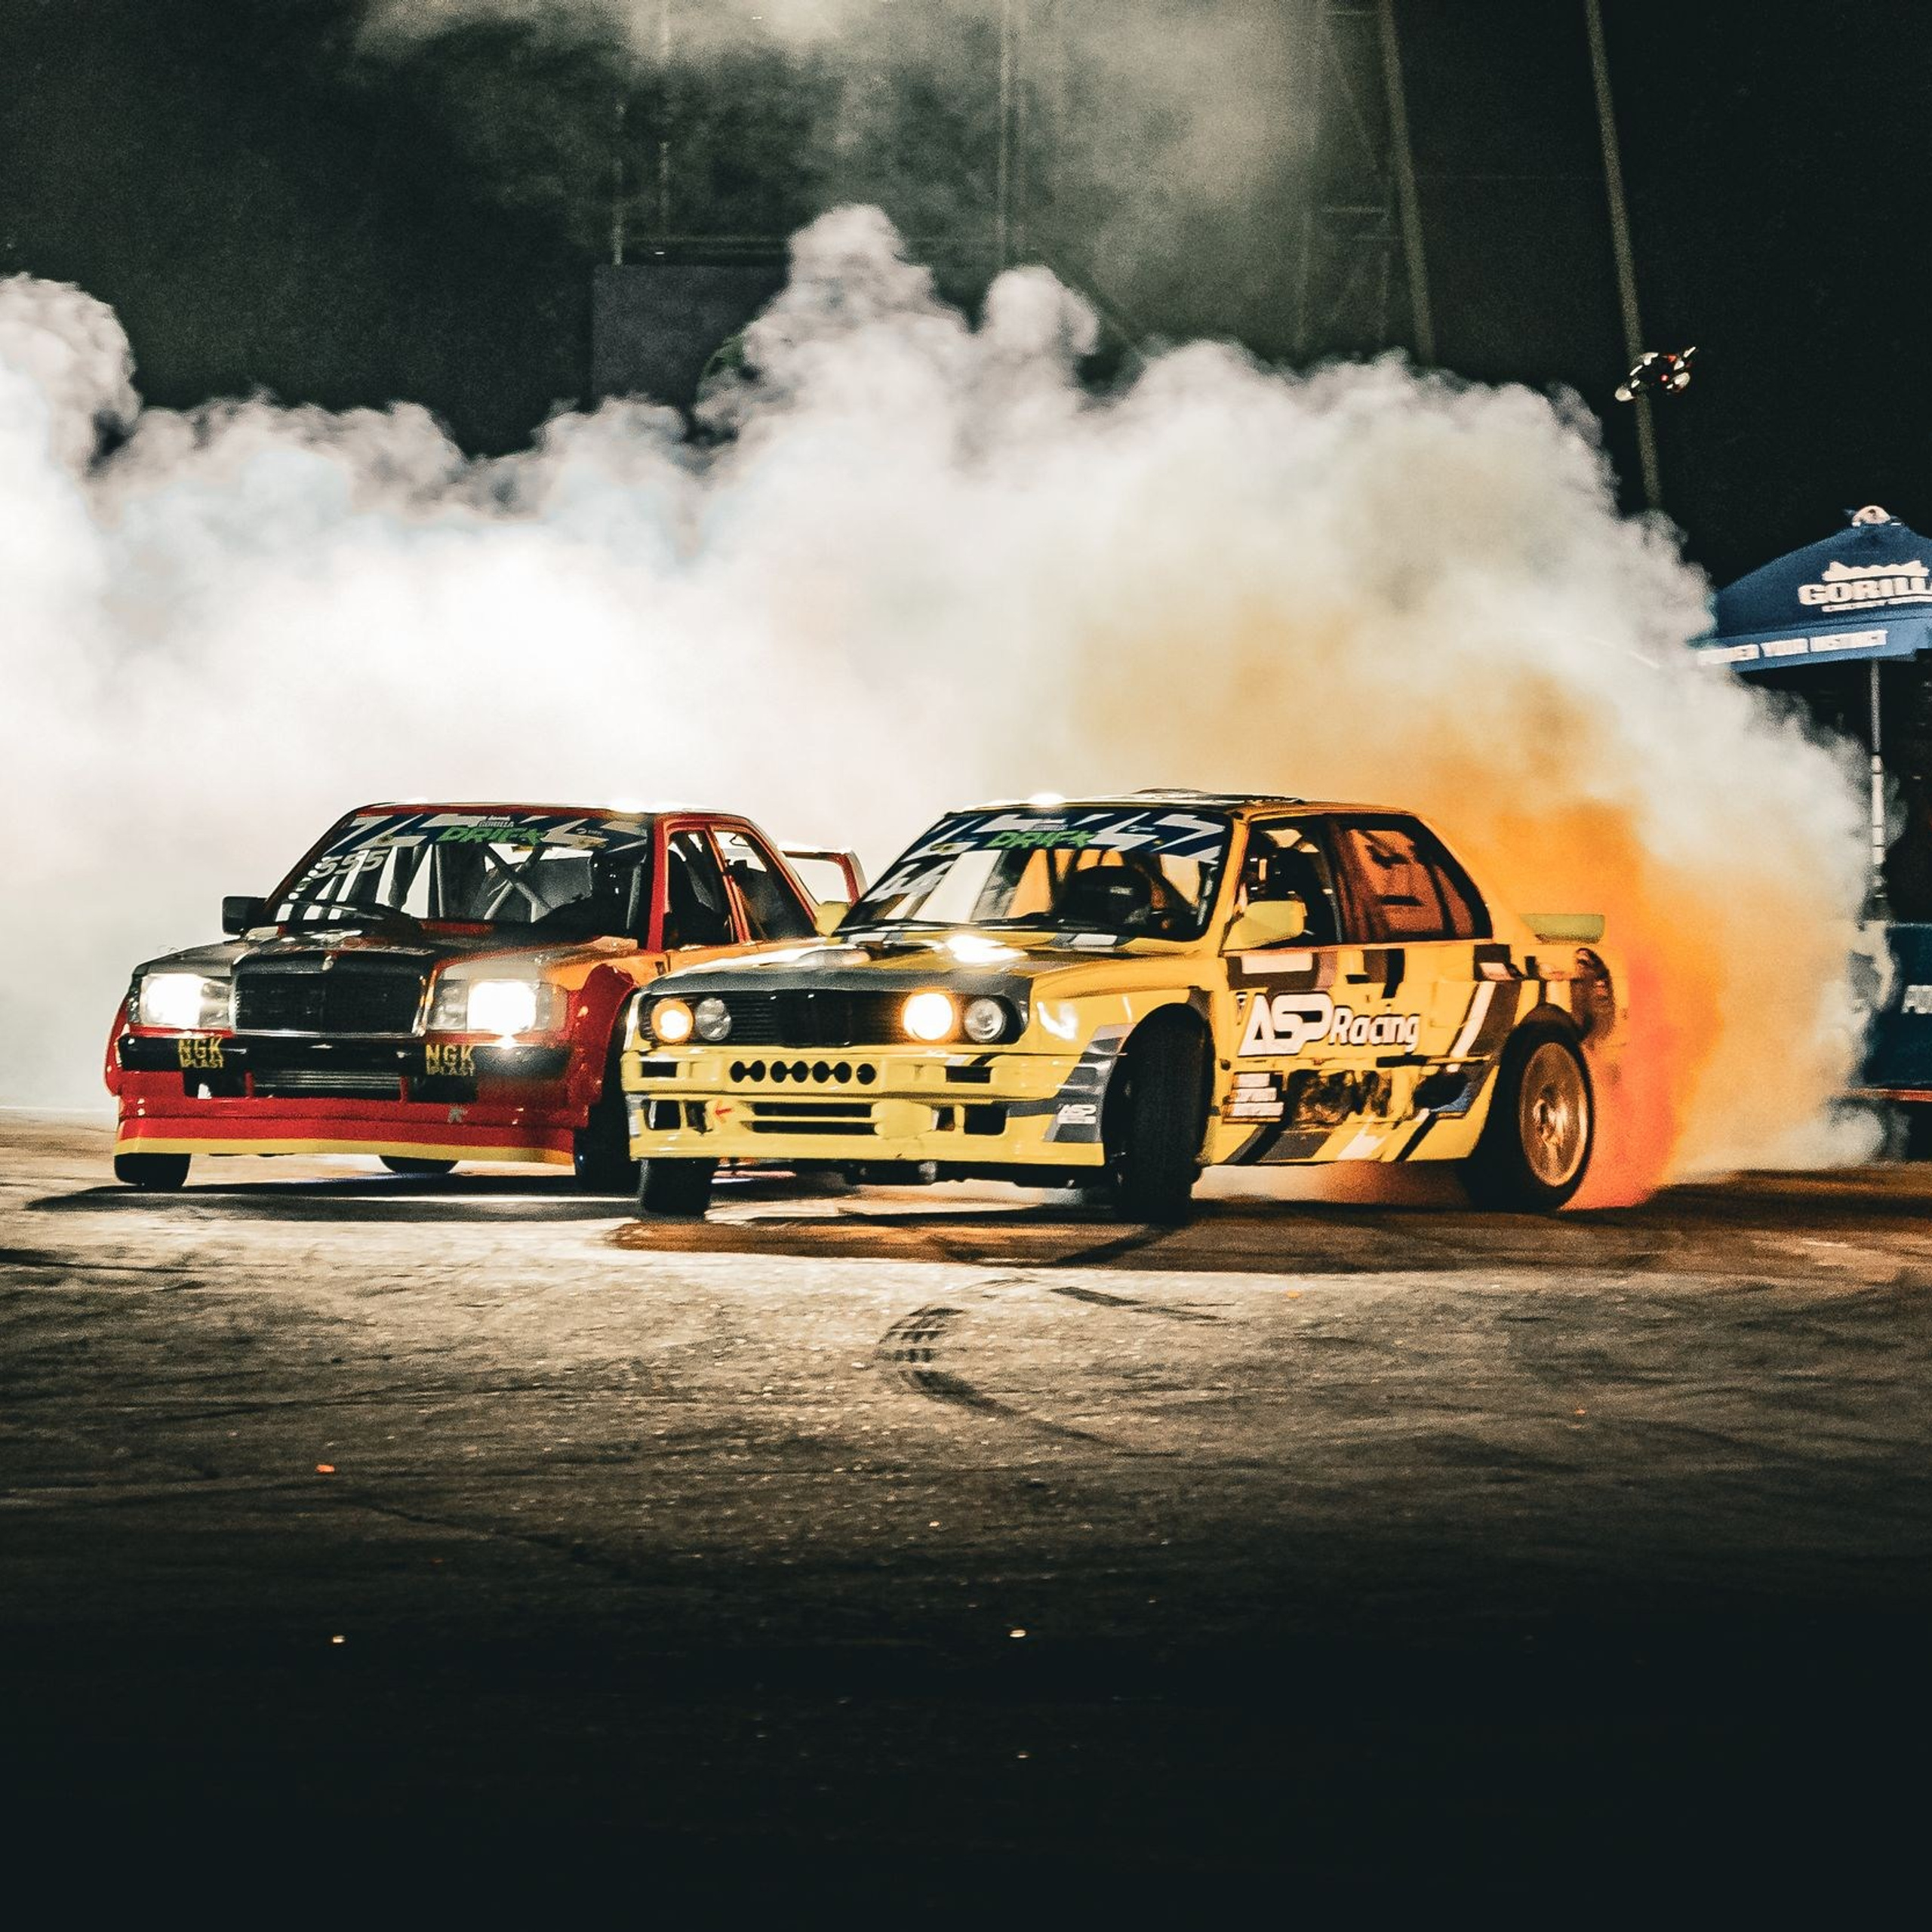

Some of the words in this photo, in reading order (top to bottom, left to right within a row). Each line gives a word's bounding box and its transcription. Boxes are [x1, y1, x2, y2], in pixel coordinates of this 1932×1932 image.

[1798, 577, 1932, 606] GORILL
[1237, 992, 1334, 1057] ASP
[1327, 1004, 1422, 1054] Racing
[426, 1044, 473, 1064] NGK
